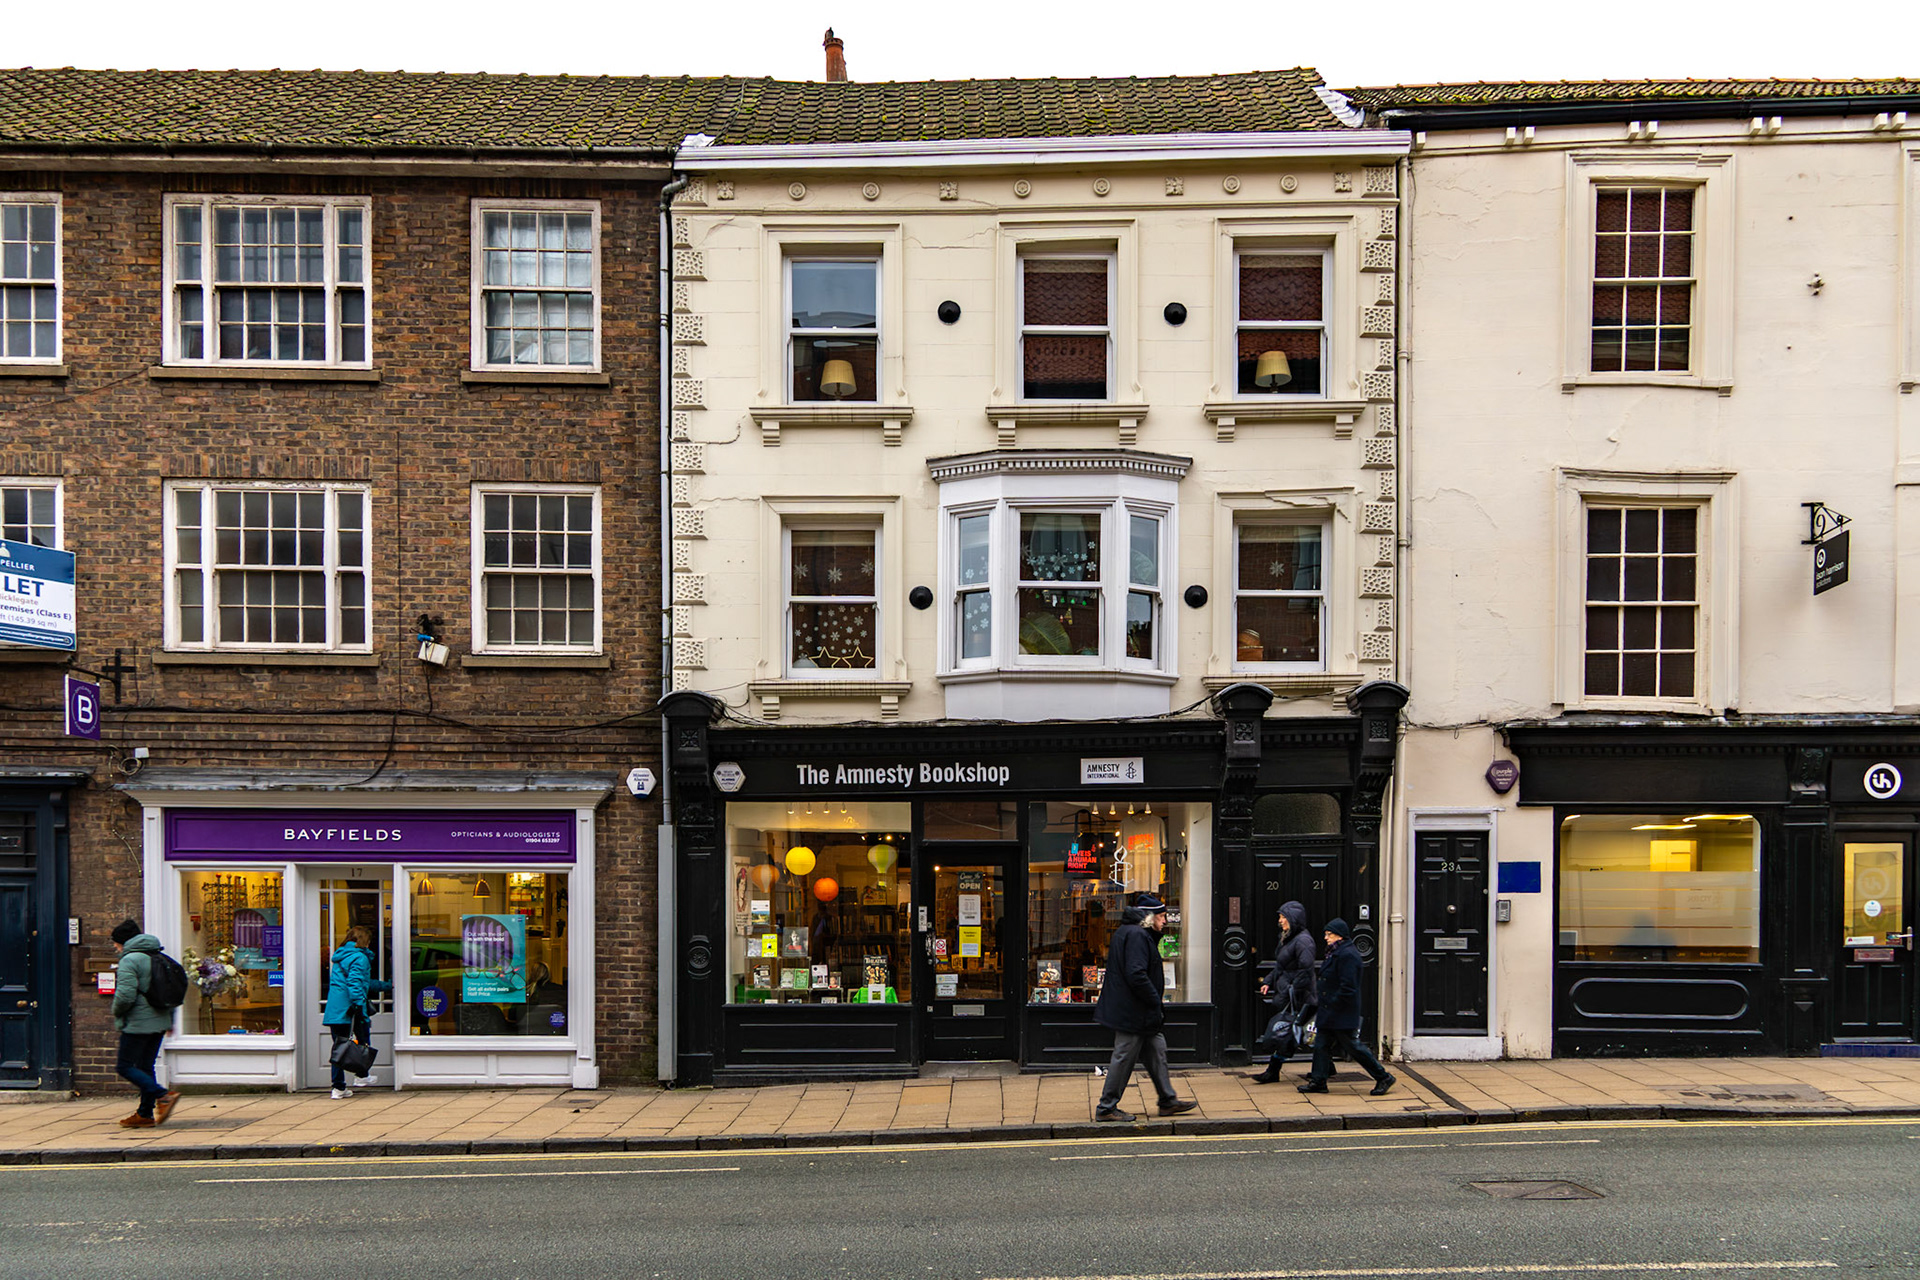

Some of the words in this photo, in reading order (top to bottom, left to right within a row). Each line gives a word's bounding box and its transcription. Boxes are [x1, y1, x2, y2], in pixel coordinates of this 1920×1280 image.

[4, 575, 44, 597] LET
[7, 614, 36, 626] (145.39
[37, 620, 46, 628] sq
[36, 608, 62, 620] (Class
[63, 612, 72, 621] E)
[78, 695, 92, 723] B
[1086, 763, 1120, 773] AMNESTY
[796, 764, 830, 785] The
[835, 763, 914, 788] Amnesty
[919, 762, 1010, 786] Bookshop
[284, 828, 402, 841] BAYFIELDS
[351, 868, 363, 877] 17
[959, 882, 981, 890] OPEN
[1266, 880, 1280, 891] 20
[1312, 880, 1324, 890] 21
